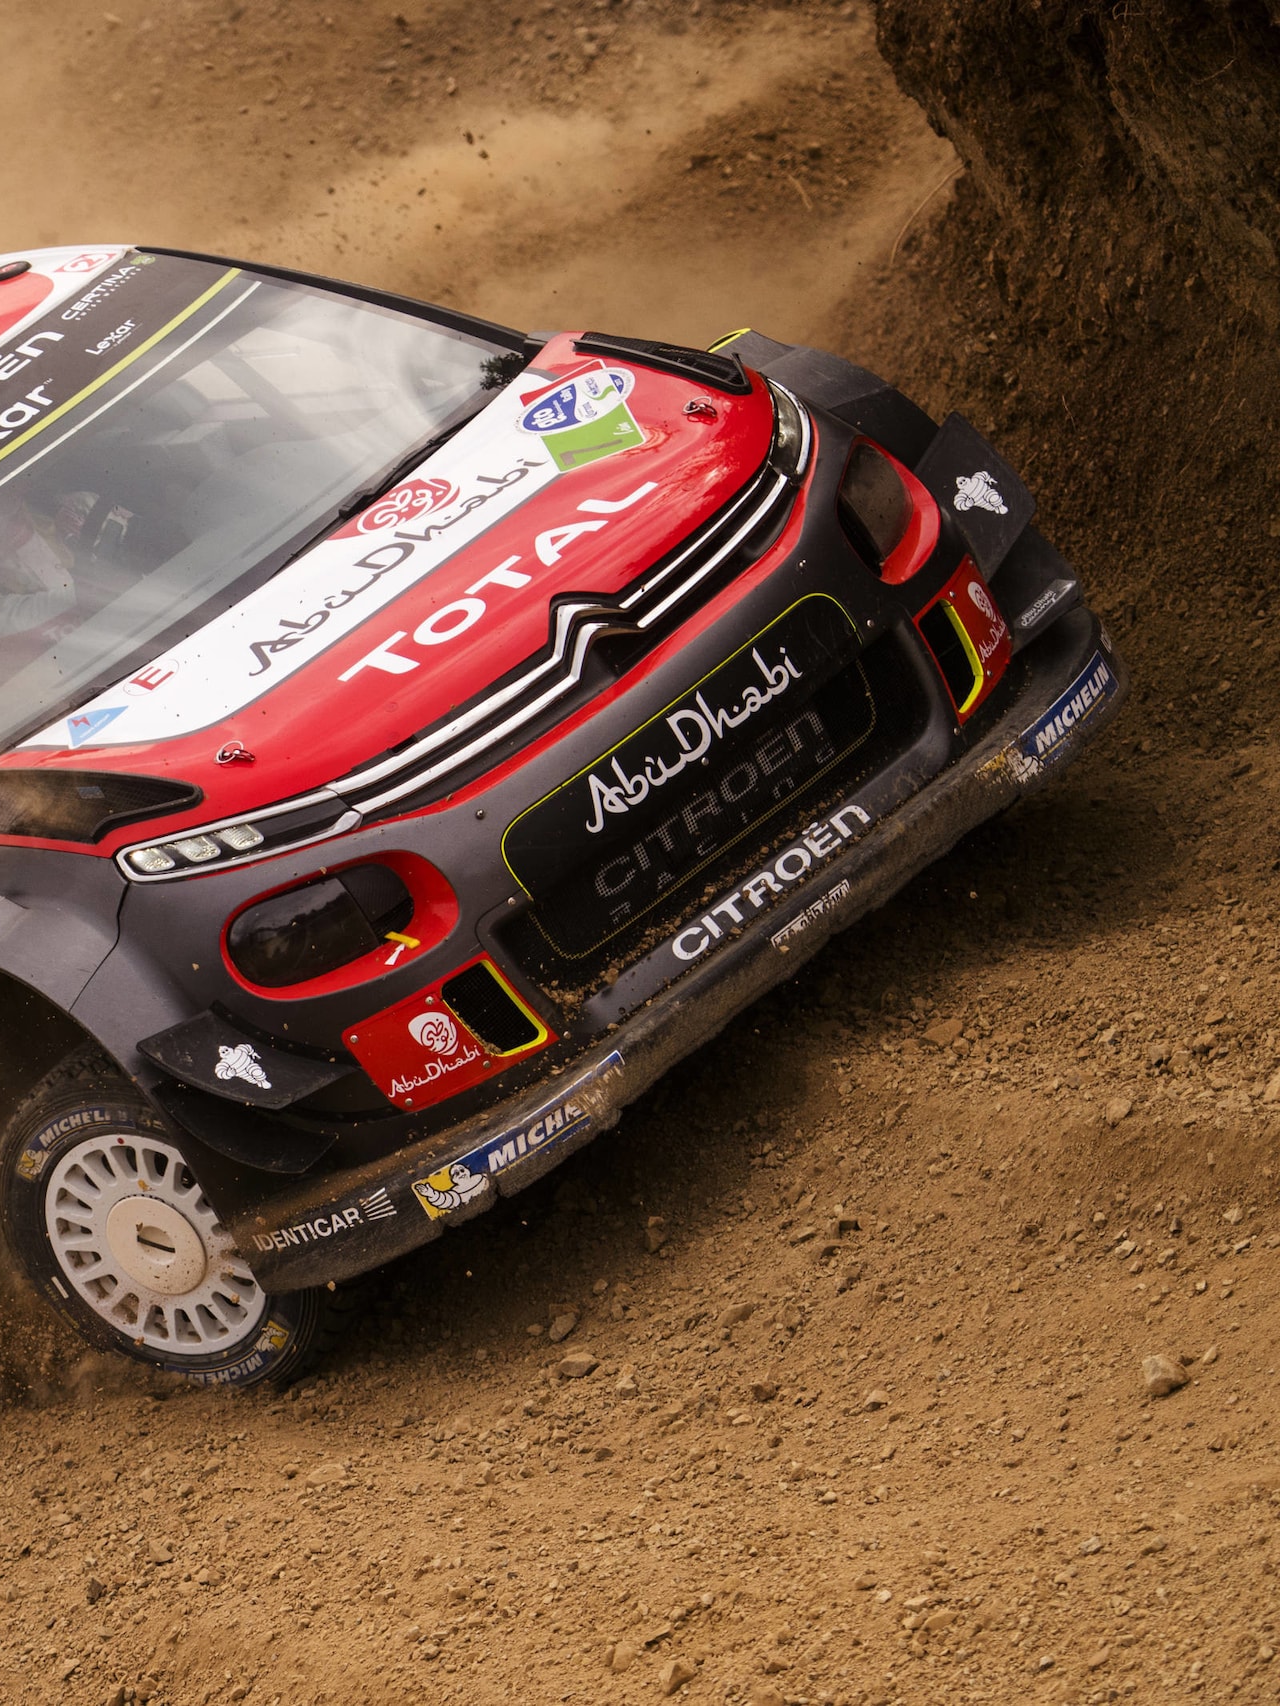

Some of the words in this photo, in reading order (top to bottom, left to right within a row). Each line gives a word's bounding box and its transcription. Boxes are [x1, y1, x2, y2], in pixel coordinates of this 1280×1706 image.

[61, 266, 136, 320] CERTINA
[85, 320, 136, 355] Lexar
[337, 481, 658, 682] TOTAL
[129, 666, 175, 691] E
[1035, 661, 1110, 755] MICHELIN
[251, 1207, 364, 1252] IDENTICAR
